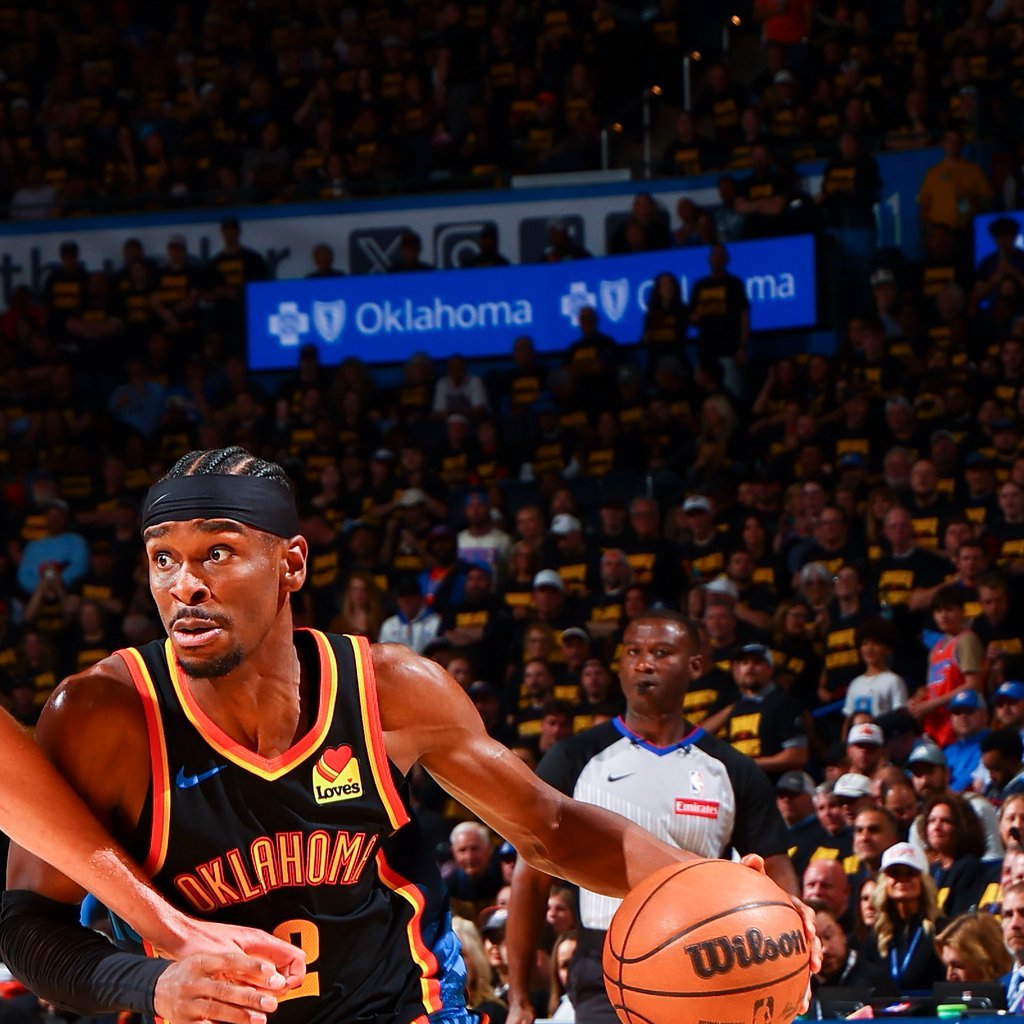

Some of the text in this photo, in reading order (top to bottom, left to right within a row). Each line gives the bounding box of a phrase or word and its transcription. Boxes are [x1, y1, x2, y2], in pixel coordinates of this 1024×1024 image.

[355, 297, 533, 335] Oklahoma
[676, 800, 719, 816] Emirates
[684, 927, 807, 979] Wilson
